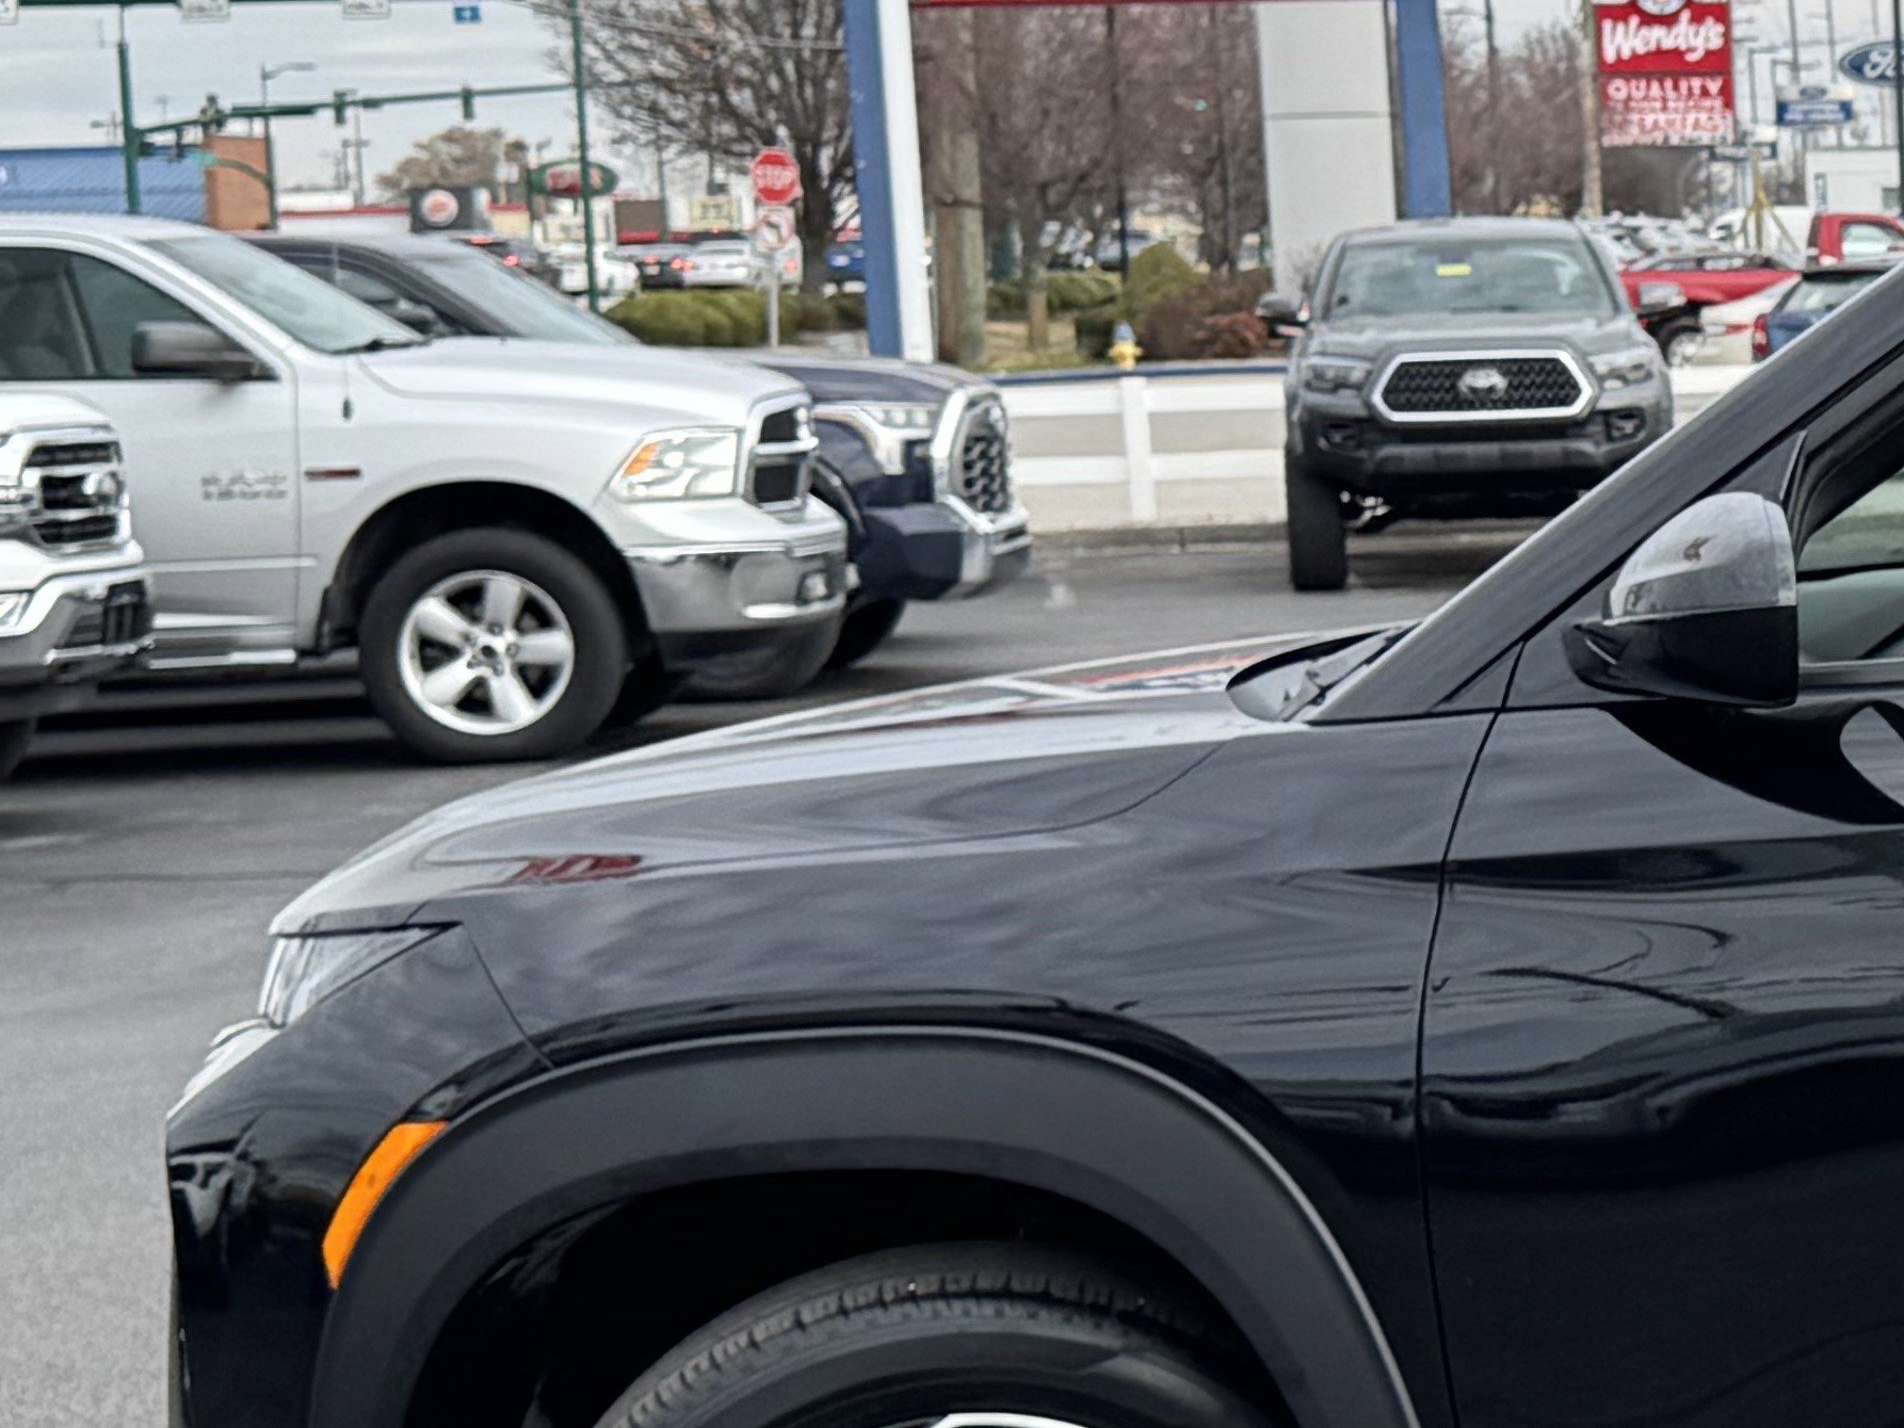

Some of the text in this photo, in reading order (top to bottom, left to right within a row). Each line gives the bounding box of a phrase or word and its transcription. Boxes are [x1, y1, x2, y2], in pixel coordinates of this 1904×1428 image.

[1601, 8, 1725, 65] Wendy's
[1607, 77, 1724, 101] QUALITY
[754, 165, 795, 189] STOP
